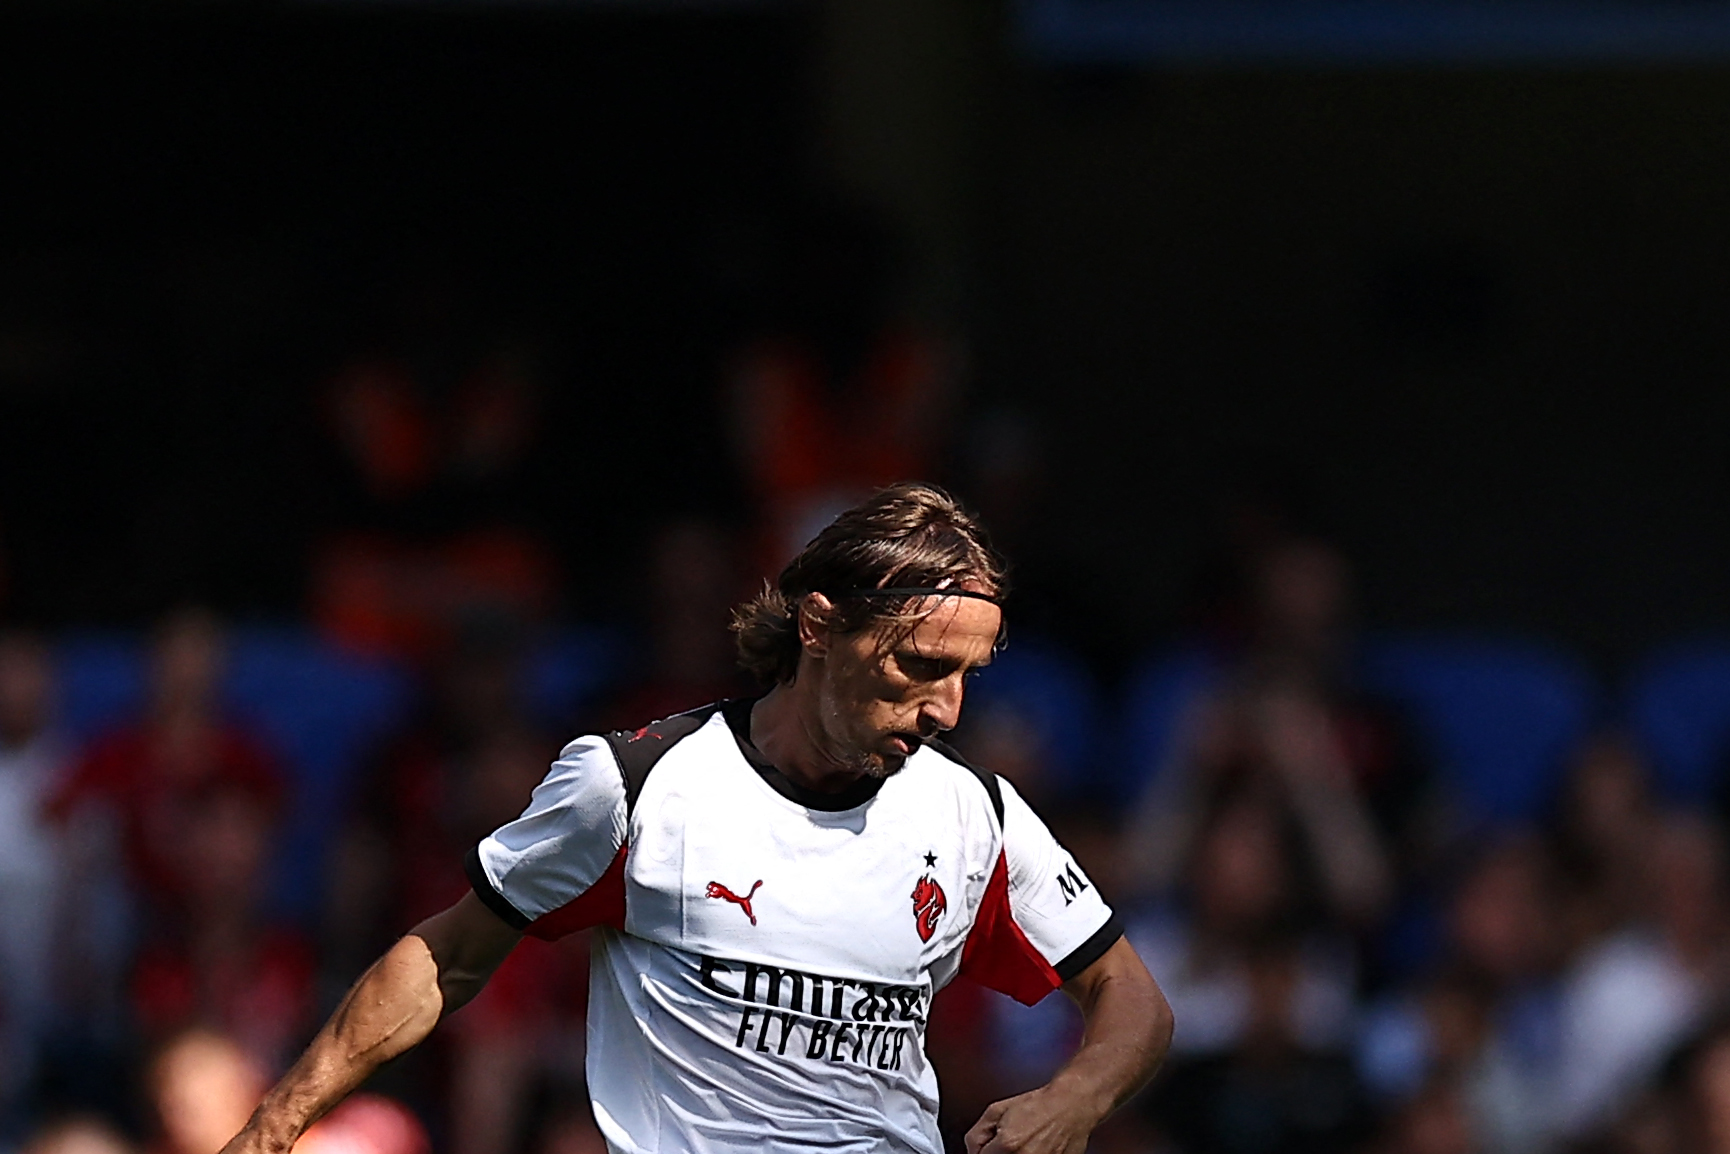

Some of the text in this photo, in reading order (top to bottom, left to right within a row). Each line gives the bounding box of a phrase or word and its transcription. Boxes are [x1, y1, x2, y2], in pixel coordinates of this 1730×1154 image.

[700, 956, 927, 1026] Emirate
[735, 1006, 908, 1071] FLY BETTER
